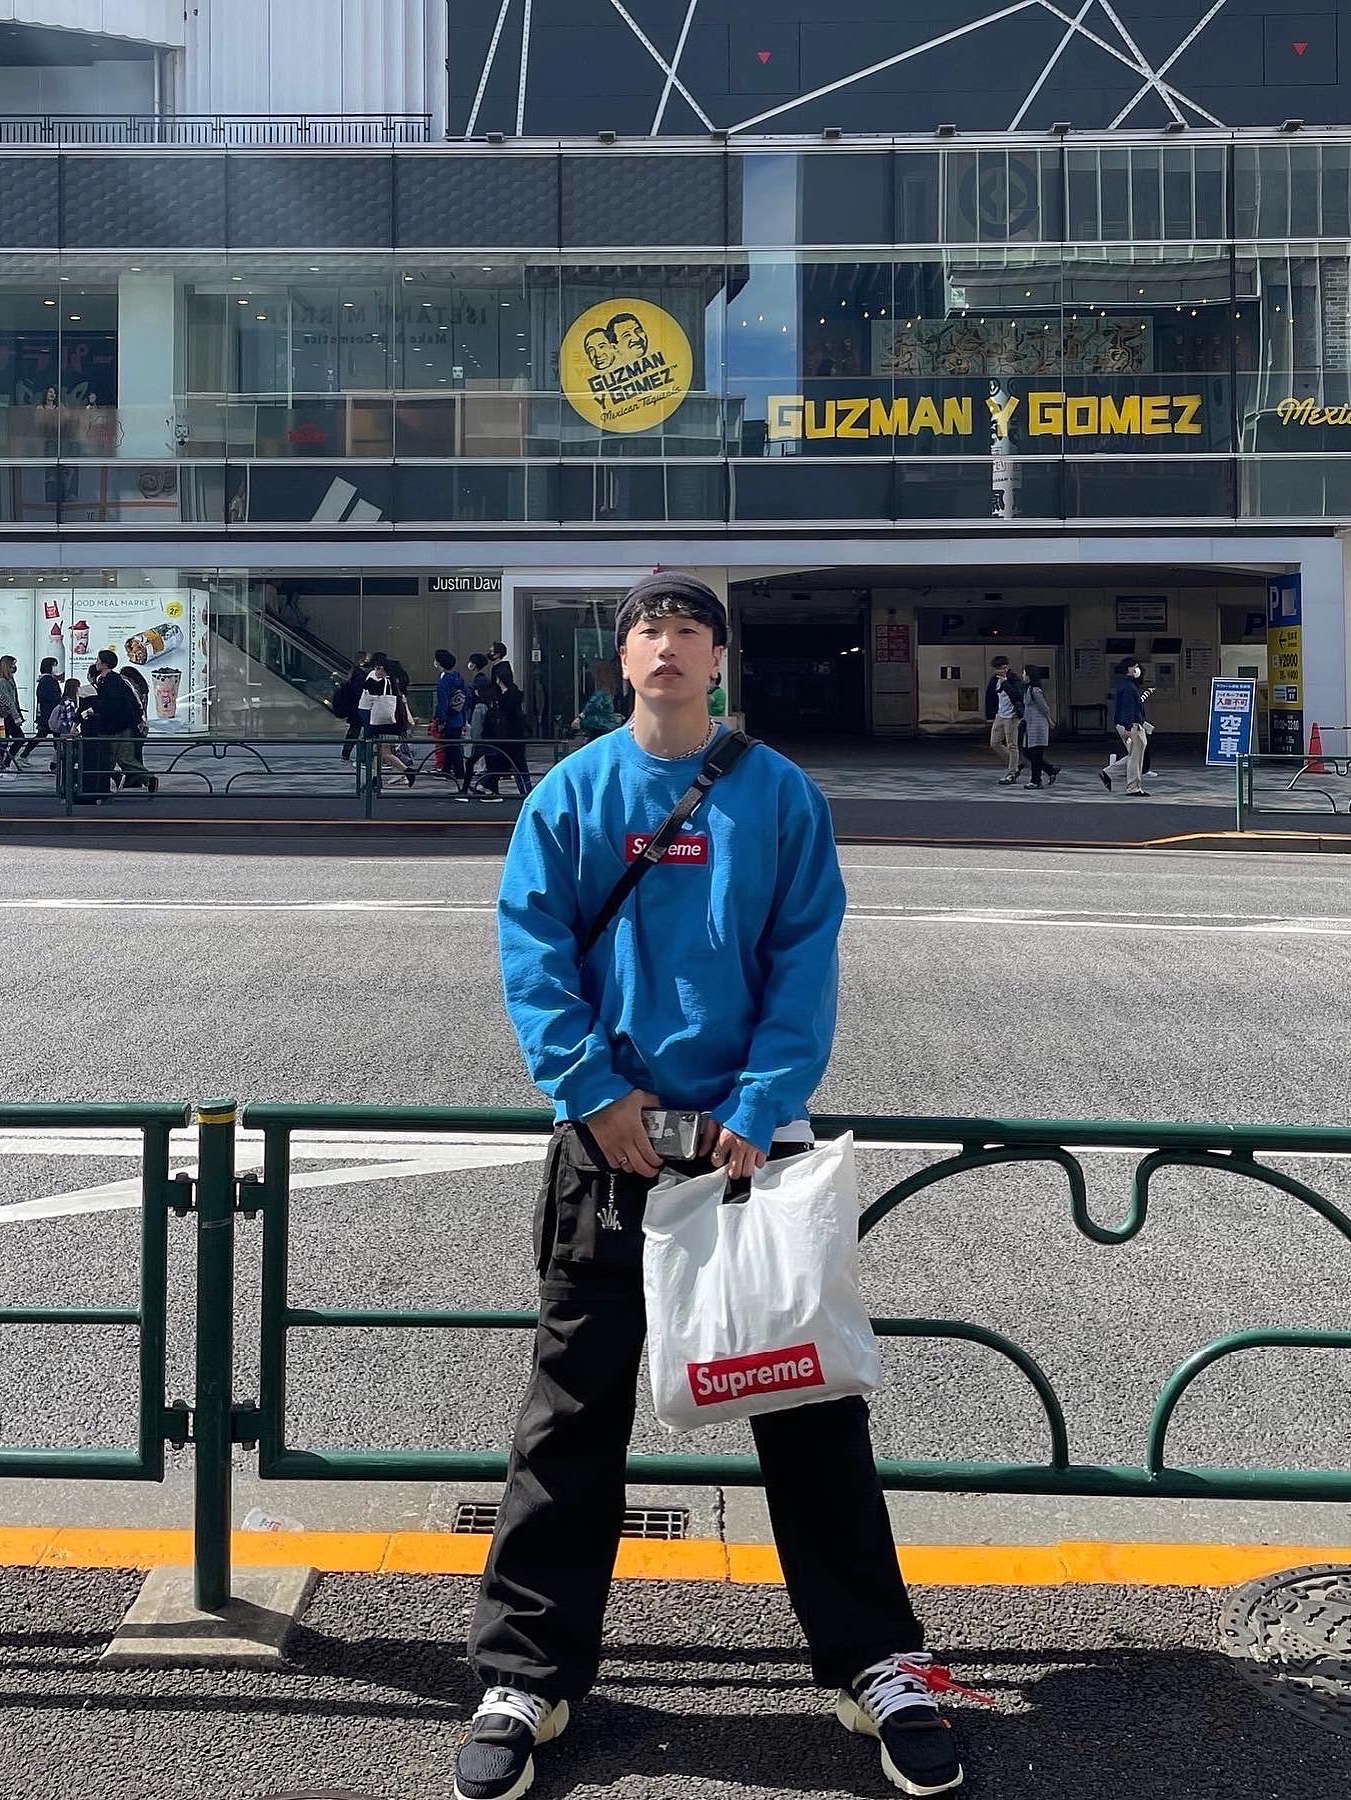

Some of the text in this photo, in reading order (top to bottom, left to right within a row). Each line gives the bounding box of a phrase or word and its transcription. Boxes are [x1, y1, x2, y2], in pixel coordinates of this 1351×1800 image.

[587, 351, 666, 392] GUZMAN
[594, 393, 607, 410] Y
[608, 367, 675, 405] GOMEZ
[767, 391, 1203, 440] GUZMAN Y GOMEZ
[70, 599, 155, 607] OOD MEAL MARKET
[433, 576, 471, 590] Justin
[1270, 586, 1280, 621] P
[1218, 714, 1242, 758] 空車
[632, 838, 702, 856] Seme
[696, 1356, 815, 1397] Supreme
